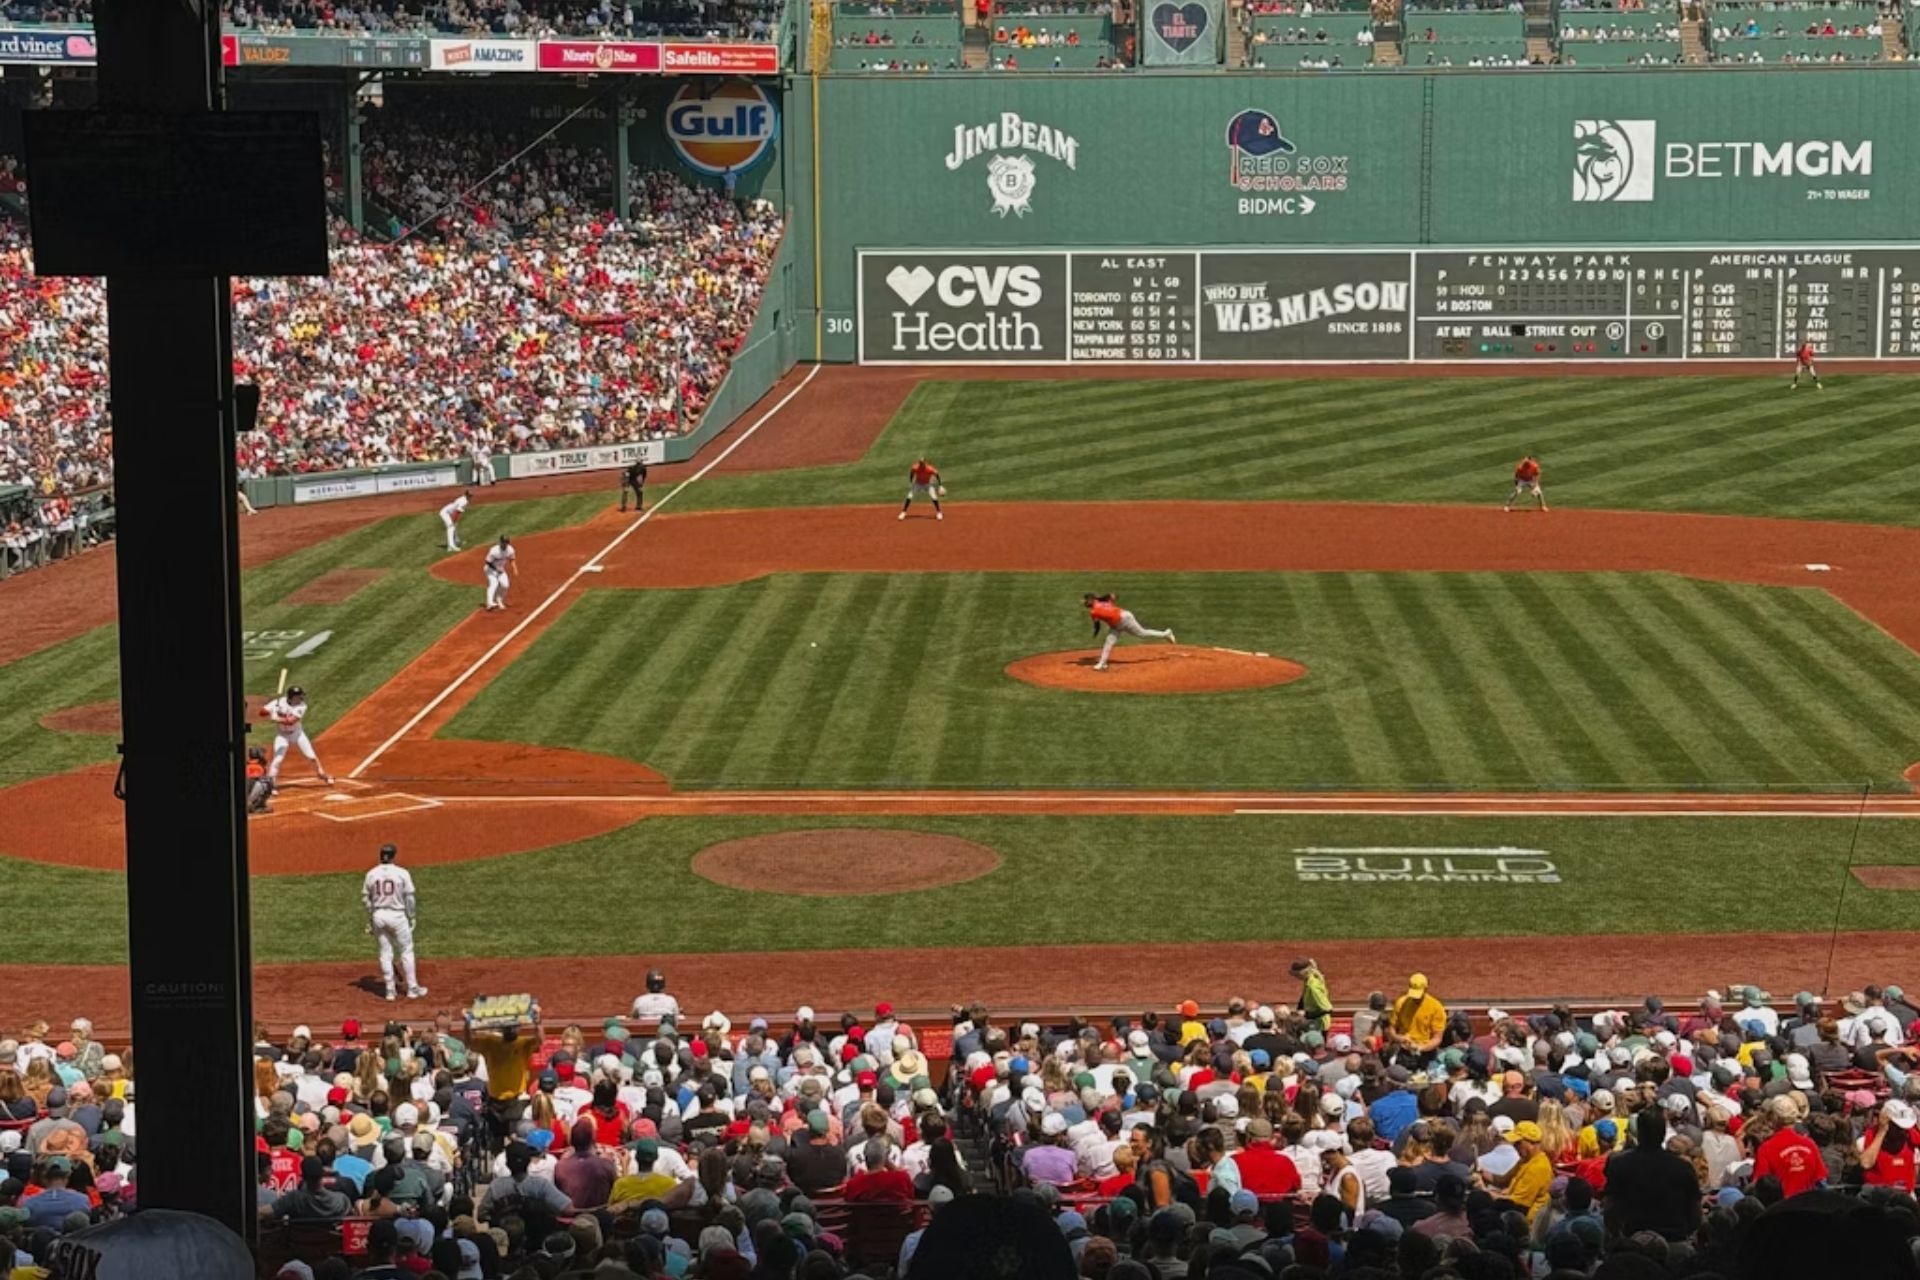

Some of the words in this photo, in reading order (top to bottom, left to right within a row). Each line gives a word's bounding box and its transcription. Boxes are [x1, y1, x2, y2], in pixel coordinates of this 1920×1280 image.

[1172, 12, 1186, 25] EL
[21, 37, 63, 54] vines
[243, 47, 290, 62] VALDEZ
[474, 48, 524, 62] AMAZING
[563, 49, 595, 65] Ninety
[614, 51, 638, 64] Nine
[666, 50, 721, 66] Safelite
[671, 104, 768, 138] Gulf
[945, 123, 998, 171] JIM
[1000, 112, 1080, 170] BEAM
[1665, 140, 1873, 178] BETMGM
[1239, 157, 1290, 175] RED
[1297, 156, 1349, 175] SOX
[1005, 174, 1016, 188] B
[1238, 175, 1348, 191] SCHOLARS
[1824, 189, 1837, 200] TO
[1837, 189, 1871, 200] WAGER
[1238, 198, 1296, 215] BIDMC
[1101, 259, 1119, 268] AL
[1127, 258, 1165, 268] EAST
[1469, 256, 1555, 266] FENWAY
[1574, 255, 1630, 265] PARK
[1711, 255, 1787, 264] AMERICAN
[1795, 254, 1851, 264] LEAGUE
[1439, 270, 1446, 280] P
[1500, 270, 1503, 280] 1
[1510, 270, 1516, 280] 2
[1521, 269, 1529, 280] 3
[1536, 269, 1544, 279] 4
[1548, 270, 1556, 280] 5
[1559, 269, 1568, 280] 6
[1576, 269, 1582, 280] 7
[1587, 270, 1594, 280] 8
[1598, 270, 1606, 280] 9
[1613, 270, 1624, 280] 10
[1637, 269, 1645, 279] R
[1655, 270, 1663, 279] H
[1672, 269, 1679, 279] E
[1695, 268, 1703, 279] P
[1747, 269, 1758, 278] IN
[1764, 268, 1772, 278] R
[1789, 268, 1797, 278] P
[1842, 268, 1853, 278] IN
[1860, 267, 1868, 278] R
[1894, 268, 1901, 278] P
[937, 264, 1043, 308] CVS
[1134, 277, 1142, 287] W
[1150, 277, 1158, 287] L
[1205, 288, 1237, 301] WHO
[1240, 286, 1268, 300] BUT
[1460, 285, 1484, 295] HOU
[1498, 285, 1504, 295] 0
[1637, 285, 1645, 295] 0
[1713, 285, 1734, 294] CWS
[1808, 284, 1828, 293] TEX
[1074, 293, 1121, 302] TORONTO
[1131, 292, 1144, 302] 65
[1148, 292, 1161, 302] 47
[1713, 296, 1734, 305] LAA
[1807, 296, 1828, 305] SEA
[1074, 307, 1113, 316] BOSTON
[1132, 306, 1143, 317] 61
[1149, 306, 1160, 317] 51
[1168, 306, 1175, 316] 4
[1451, 300, 1492, 311] BOSTON
[1671, 300, 1679, 310] 0
[1716, 308, 1731, 317] KC
[1810, 308, 1824, 317] AZ
[826, 318, 853, 334] 310
[1073, 320, 1094, 330] NEW
[1098, 321, 1123, 330] YORK
[1131, 320, 1145, 330] 60
[1149, 320, 1160, 330] 51
[1168, 320, 1175, 330] 4
[1328, 322, 1368, 333] SINCE
[1372, 322, 1402, 333] 1898
[1712, 320, 1734, 329] TOR
[1807, 320, 1827, 328] ATH
[892, 311, 1043, 352] Health
[1436, 326, 1450, 336] AT
[1453, 326, 1472, 337] BAT
[1481, 325, 1512, 338] BALL
[1524, 324, 1566, 338] STRIKE
[1570, 326, 1596, 336] OUT
[1712, 332, 1734, 341] LAD
[1807, 332, 1826, 340] MIN
[1074, 335, 1104, 344] TAMPA
[1107, 335, 1125, 344] BAY
[1131, 334, 1144, 344] 55
[1148, 334, 1160, 344] 57
[1166, 334, 1177, 344] 10
[1073, 349, 1125, 358] BALTIMORE
[1132, 348, 1143, 358] 51
[1148, 348, 1161, 358] 60
[1166, 348, 1177, 358] 13
[1716, 344, 1730, 352] TB
[1785, 344, 1795, 352] 54
[560, 452, 588, 465] TRULY
[622, 447, 649, 459] TRULY
[1295, 857, 1556, 872] BUILD
[1298, 872, 1562, 882] SUBMARINES
[374, 880, 395, 896] 10
